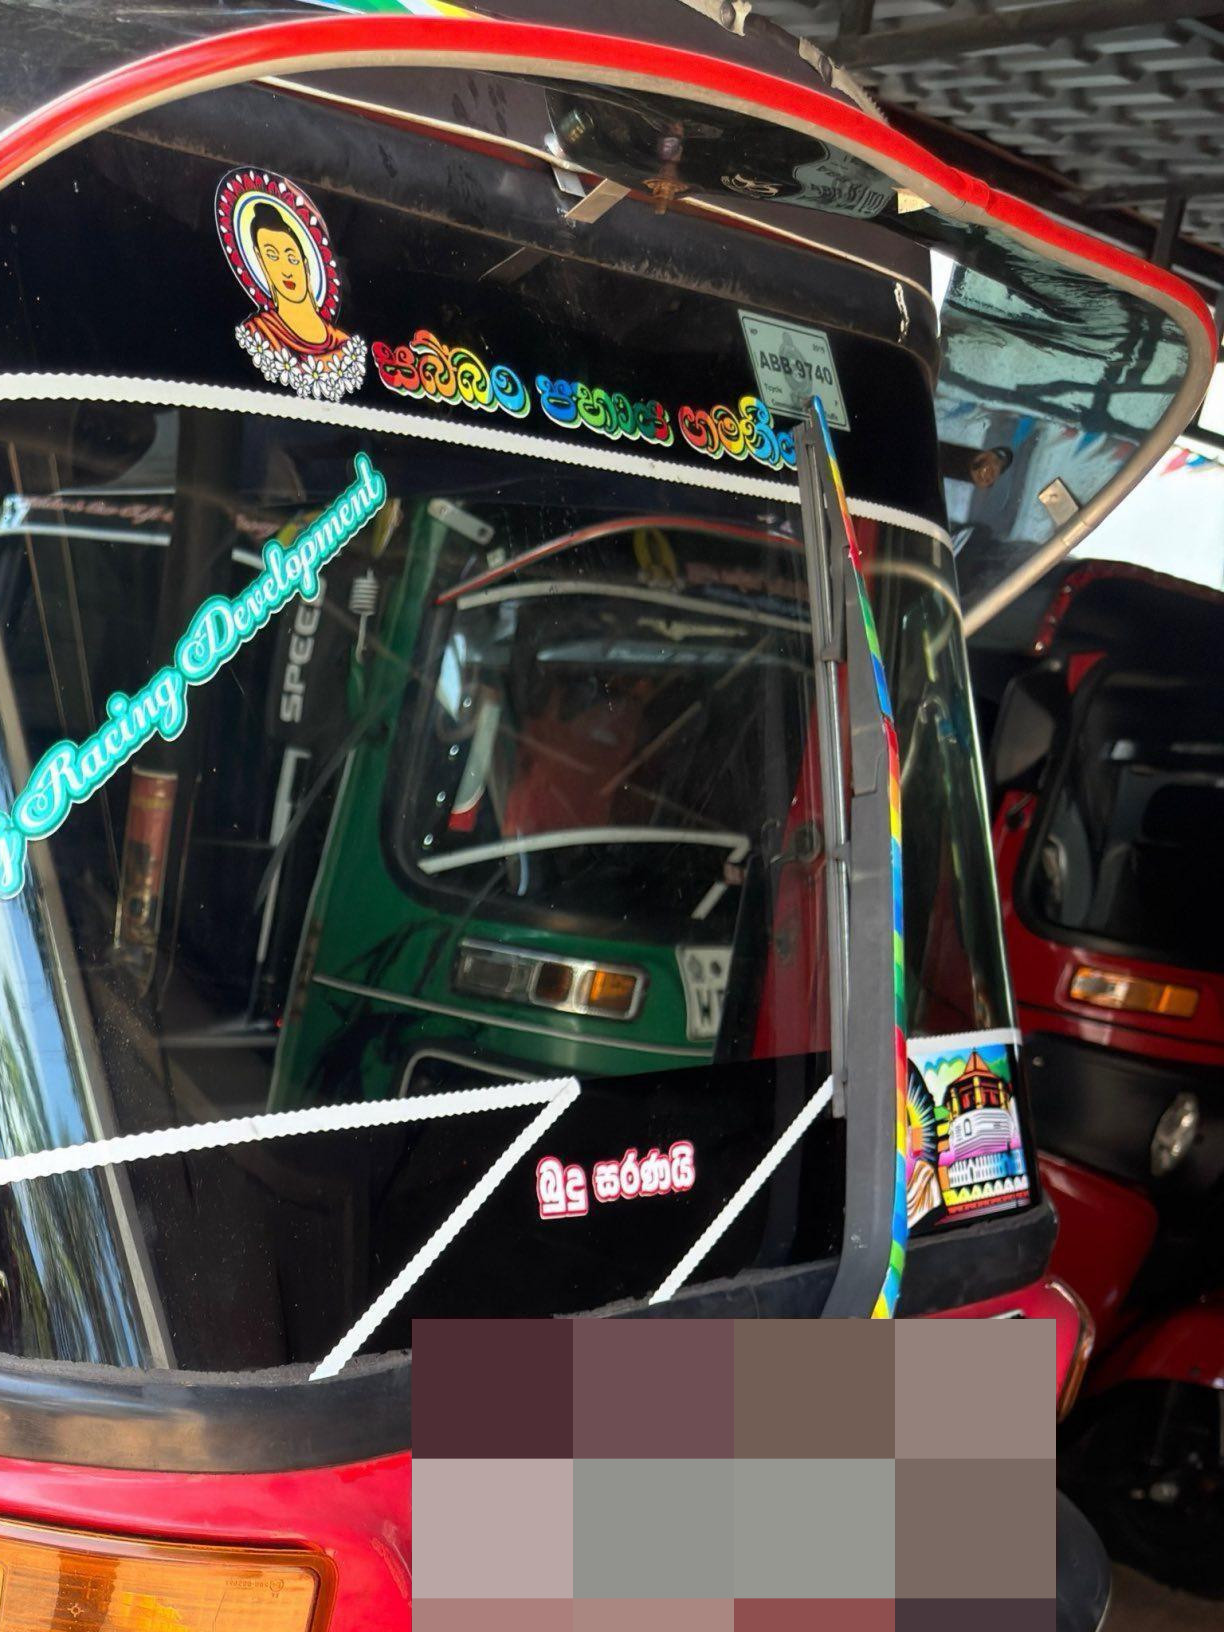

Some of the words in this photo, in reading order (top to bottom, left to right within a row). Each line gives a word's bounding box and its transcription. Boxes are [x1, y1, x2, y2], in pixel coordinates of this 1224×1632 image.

[13, 668, 187, 839] Racing
[177, 453, 386, 684] Development
[279, 578, 326, 723] SPEE
[537, 1157, 589, 1219] බුදු
[592, 1140, 696, 1203] සරණයි
